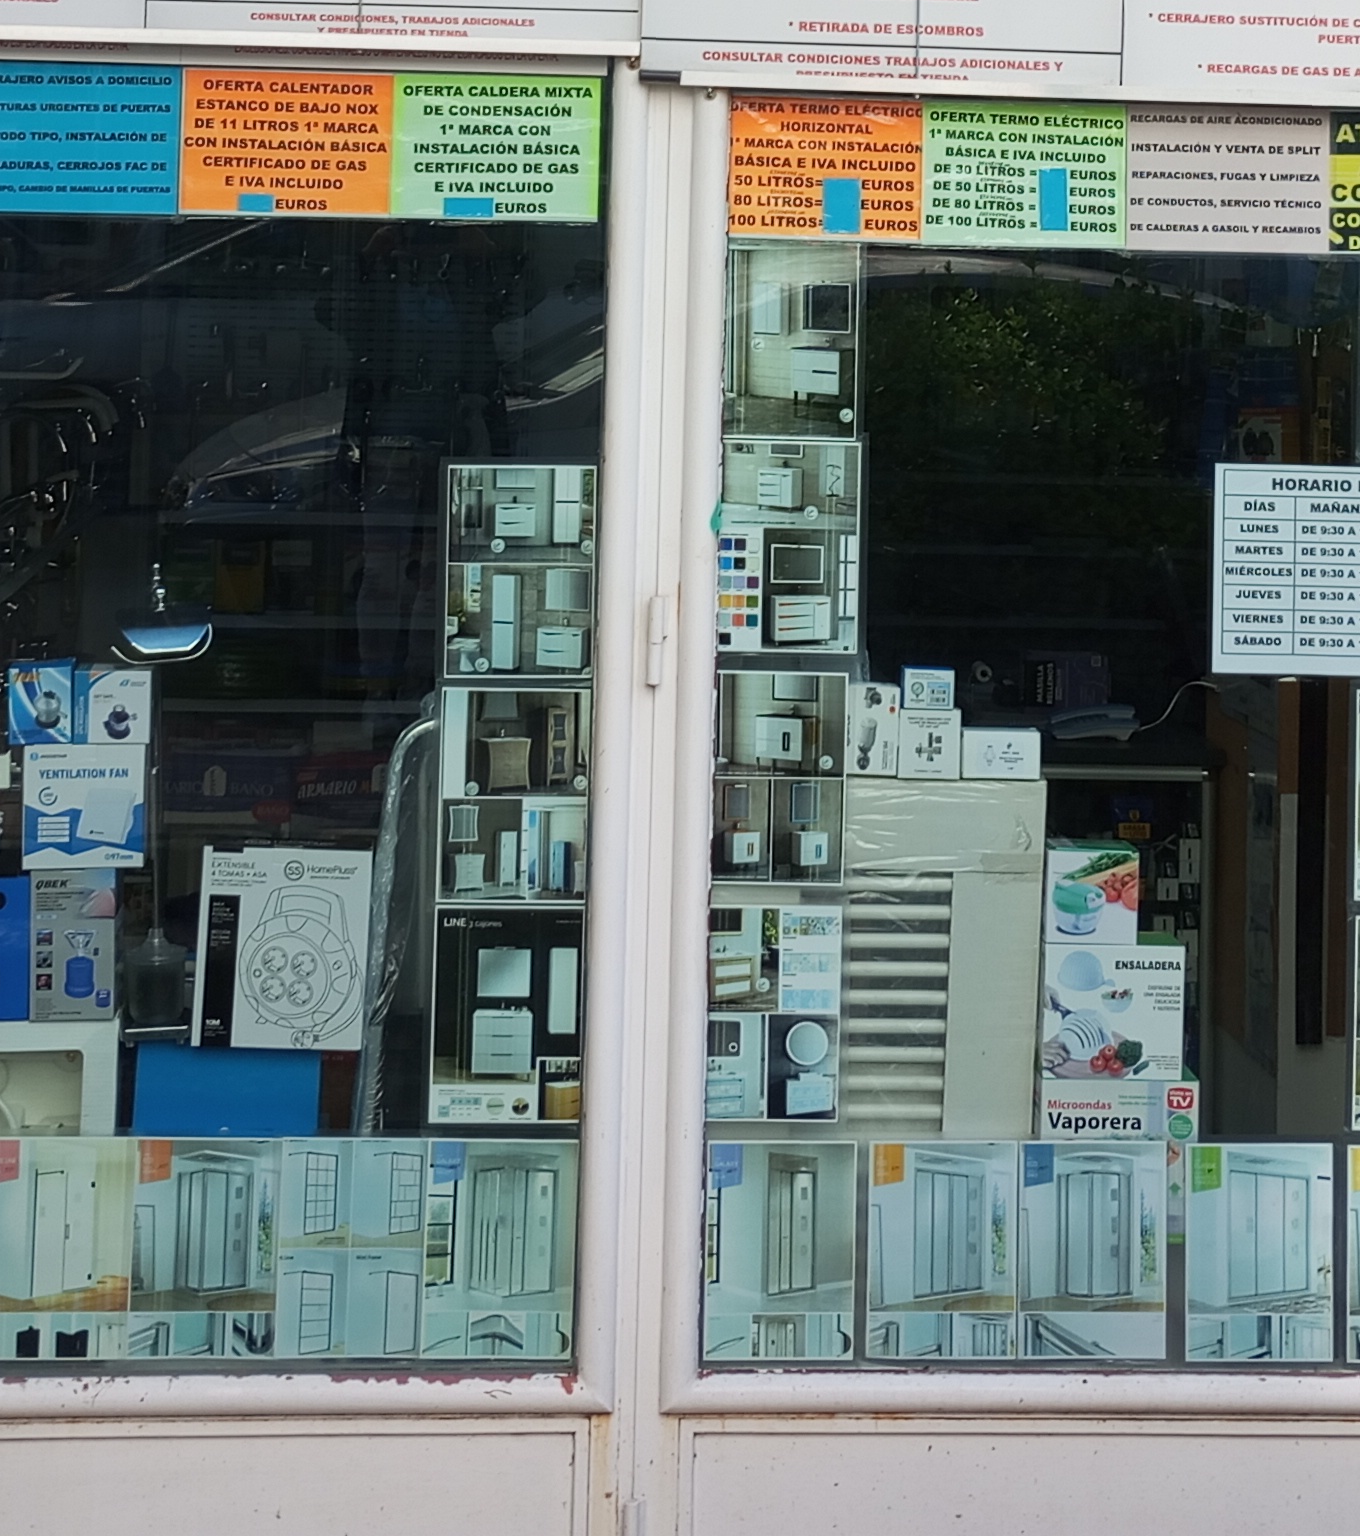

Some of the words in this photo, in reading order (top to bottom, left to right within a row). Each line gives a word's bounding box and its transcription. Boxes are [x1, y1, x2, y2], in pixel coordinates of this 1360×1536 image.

[203, 78, 265, 93] OFERTA
[269, 81, 374, 96] CALENTADOR
[403, 85, 464, 97] OFERTA
[468, 85, 541, 98] CALDERA
[544, 86, 593, 99] MIXTA
[1271, 477, 1352, 493] HORARIO
[1243, 499, 1276, 512] DÍAS
[38, 768, 107, 780] VENTILATION
[109, 767, 129, 779] FAN
[35, 879, 70, 891] QBEK
[1114, 960, 1182, 971] ENSALADERA
[1047, 1099, 1112, 1111] Microondas
[1047, 1111, 1142, 1135] Vaporera
